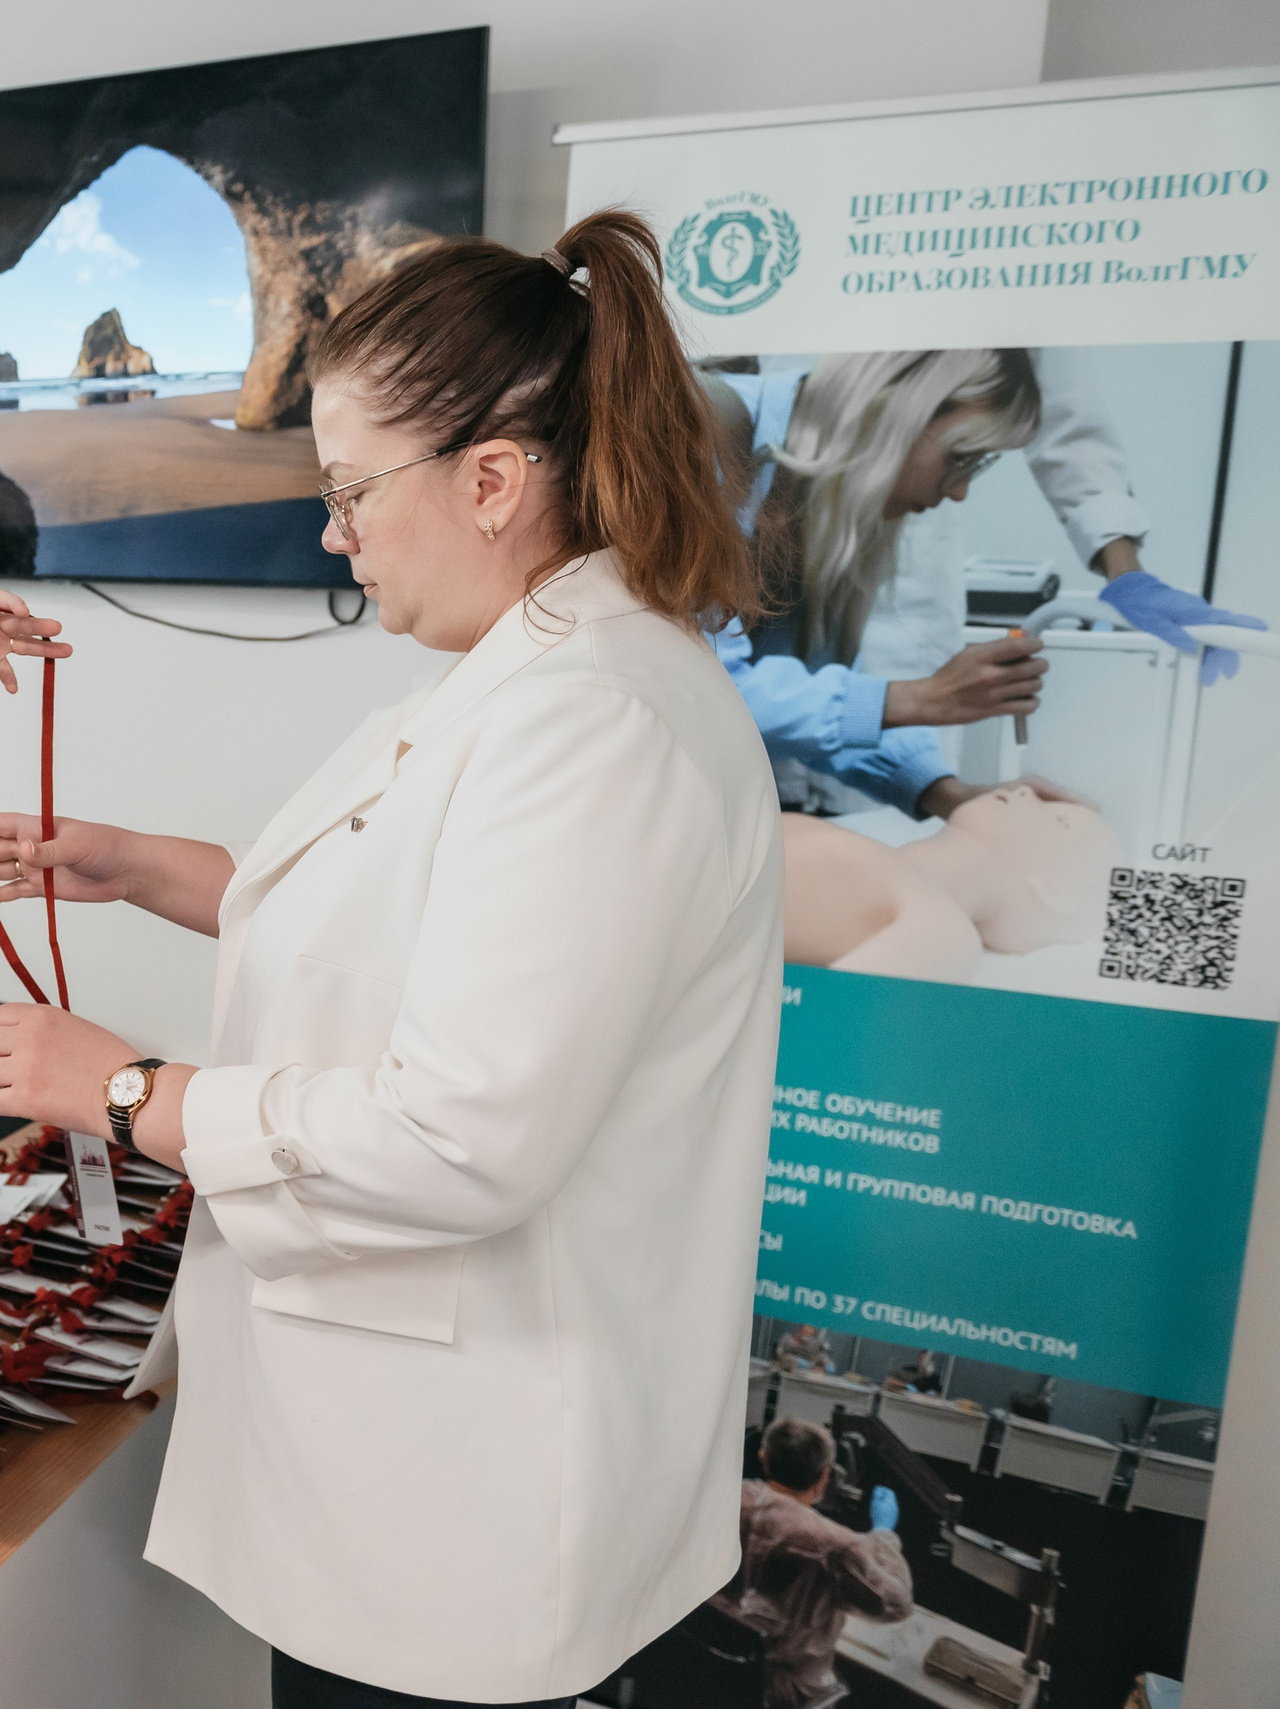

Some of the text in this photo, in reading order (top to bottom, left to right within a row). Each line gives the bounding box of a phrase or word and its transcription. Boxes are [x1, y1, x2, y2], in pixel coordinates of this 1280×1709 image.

[849, 168, 1269, 224] ЦЕНТР ЭЛЕКТРОННОГО
[845, 218, 1140, 258] МЕДИЦИНСКОГО
[841, 252, 1259, 295] ОБРАЗОВАНИЯ ВолгГМУ
[1151, 842, 1213, 863] САЙТ
[824, 1092, 942, 1129] ОБУЧЕНИЕ
[794, 1112, 940, 1154] РАБОТНИКОВ
[824, 1167, 843, 1190] И
[846, 1171, 976, 1212] ГРУППОВАЯ
[980, 1194, 1138, 1240] ПОДГОТОВКА
[754, 1278, 1079, 1360] ЛЫ ПО 37 СПЕЦИАЛЬНОСТЯМ
